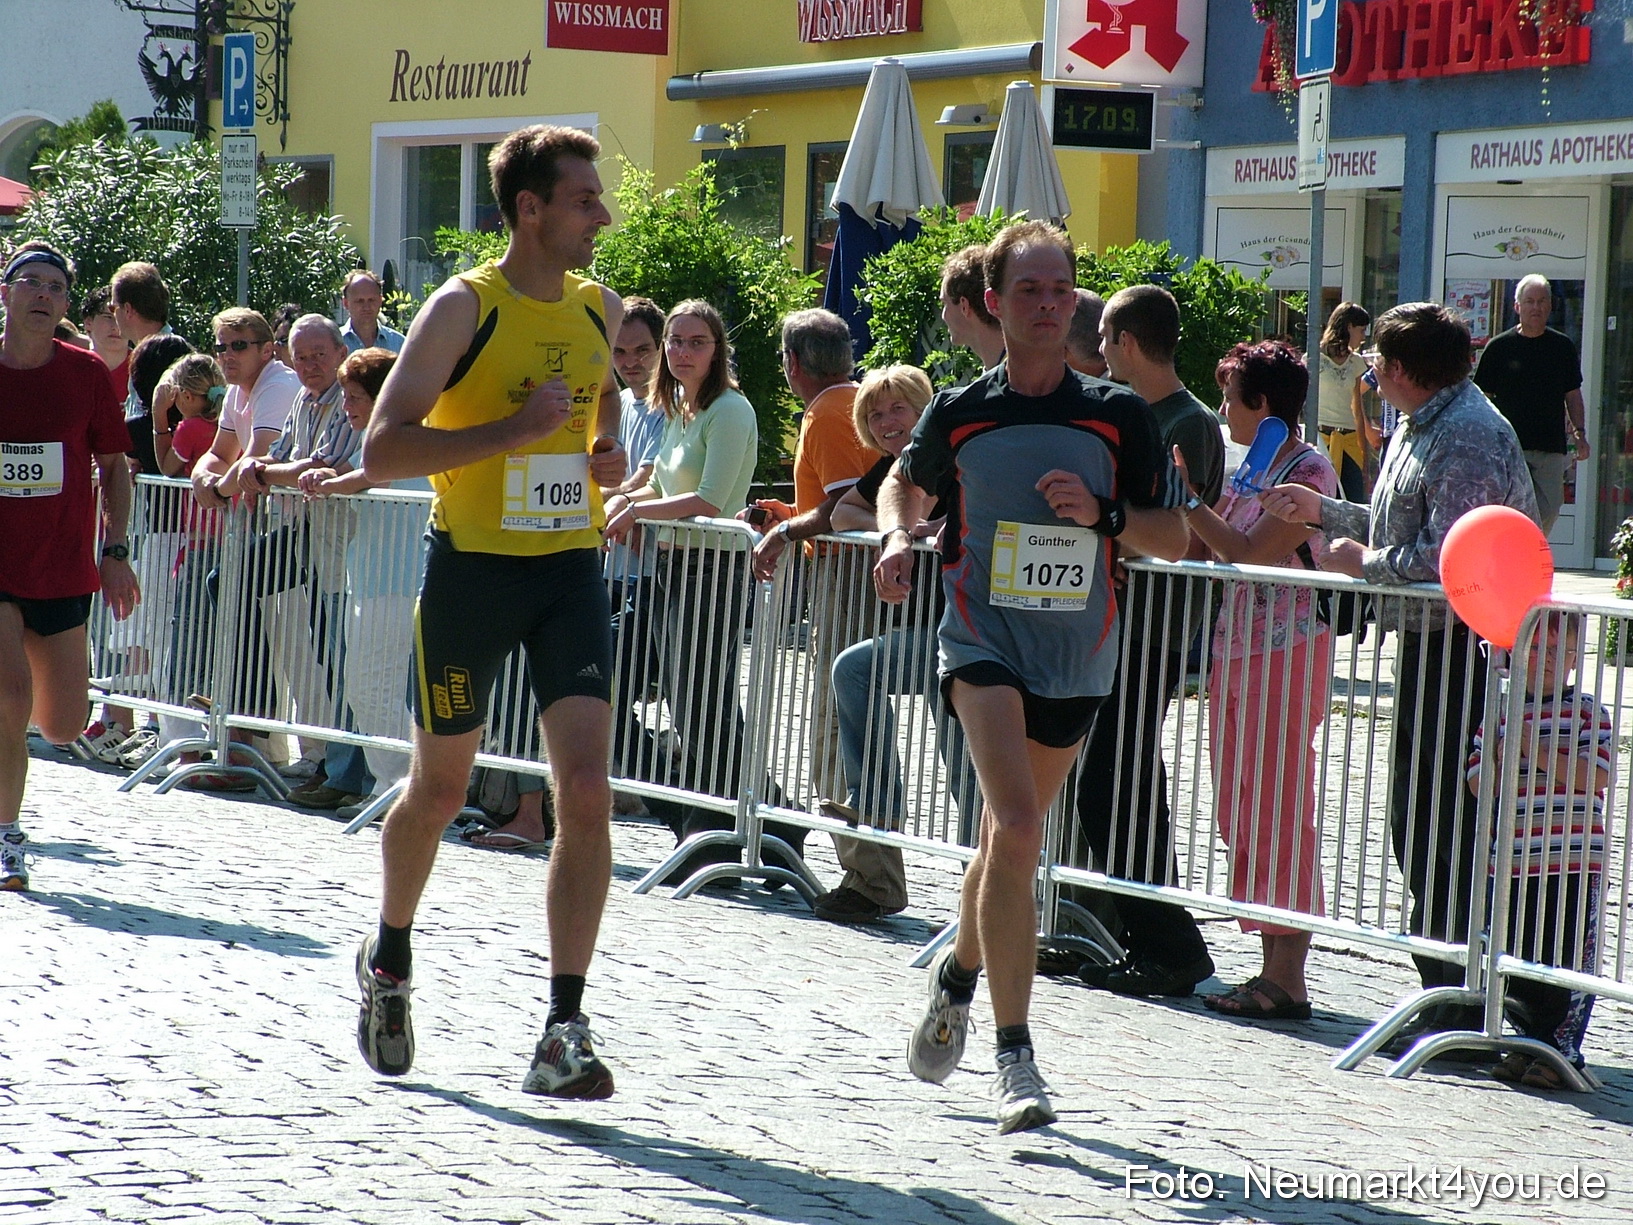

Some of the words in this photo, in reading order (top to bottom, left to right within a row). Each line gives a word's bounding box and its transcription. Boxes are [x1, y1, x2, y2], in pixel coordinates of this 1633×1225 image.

[555, 1, 663, 30] WISSMACH
[1251, 0, 1592, 93] AOTHEKE
[230, 47, 247, 116] P
[389, 49, 532, 102] Restaurant
[240, 142, 249, 153] mit
[1471, 139, 1543, 169] RATHAUS
[1550, 133, 1633, 164] APOTHEKE
[224, 156, 253, 169] Parkschein
[1235, 156, 1296, 183] RATHAUS
[1327, 150, 1377, 177] OTHEKE
[226, 172, 251, 186] werktags
[1240, 238, 1261, 249] Haus
[1263, 236, 1276, 244] der
[1278, 235, 1310, 246] Gesund
[1473, 228, 1496, 240] Haus
[1498, 226, 1512, 234] der
[1515, 225, 1566, 240] Gesundheit
[1, 443, 44, 455] thomas
[3, 463, 44, 481] 389
[534, 481, 582, 506] 1089
[1028, 535, 1077, 547] Günther
[1022, 562, 1083, 587] 1073
[450, 672, 471, 709] Run!
